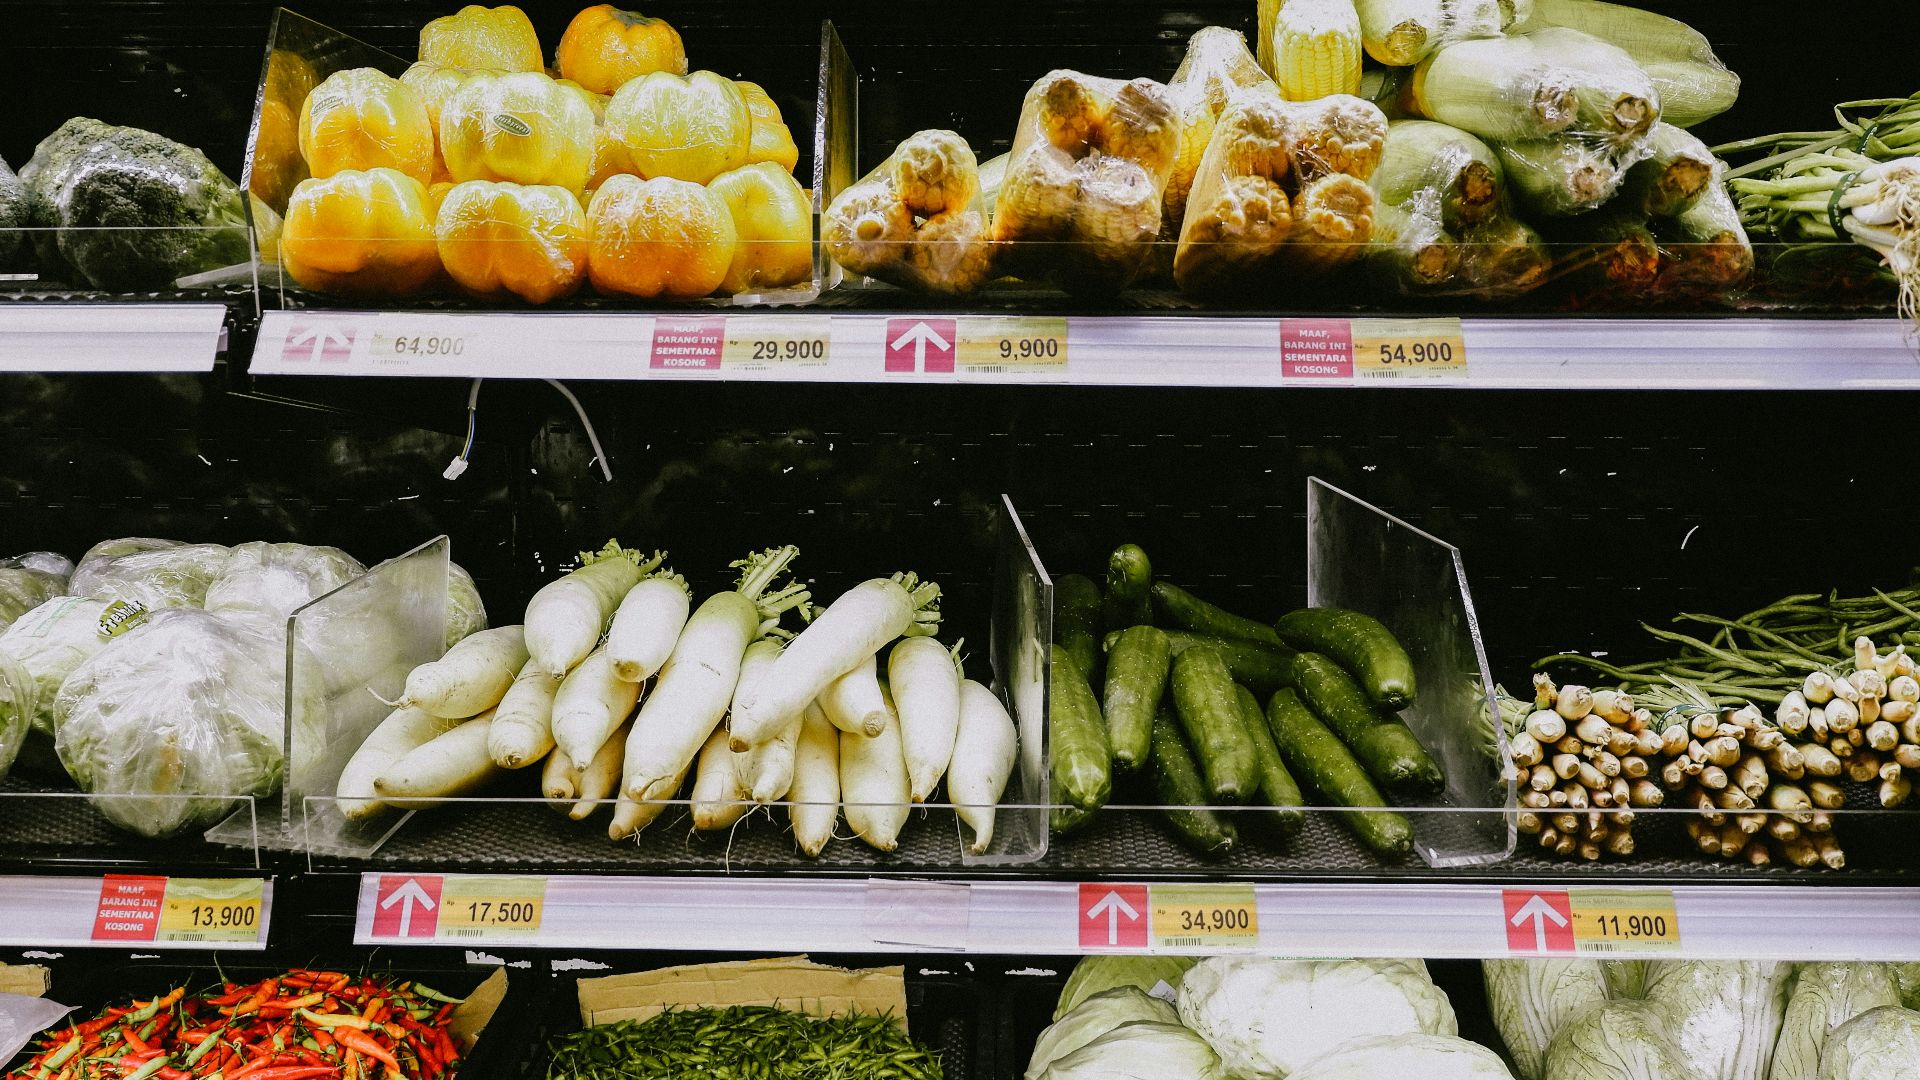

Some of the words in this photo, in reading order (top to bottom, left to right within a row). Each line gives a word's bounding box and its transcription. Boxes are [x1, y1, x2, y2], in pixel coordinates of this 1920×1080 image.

[1299, 329, 1331, 339] MAAF,
[657, 336, 698, 344] BARANG
[701, 336, 718, 344] INI
[394, 336, 465, 357] 64,900
[752, 339, 824, 362] 29,900
[1000, 338, 1058, 361] 9,900
[1284, 341, 1327, 350] BARANG
[1329, 342, 1347, 350] INI
[655, 347, 717, 355] SEMENTARA
[1380, 342, 1453, 366] 54,900
[663, 358, 707, 367] KOSONG
[1284, 353, 1347, 362] SEMENTARA
[1294, 365, 1339, 374] KOSONG
[118, 885, 145, 896] MAAF,
[101, 897, 140, 907] BARANG
[141, 898, 158, 907] INI
[98, 909, 155, 919] SEMENTARA
[191, 905, 255, 929] 13,900
[468, 901, 534, 925] 17,500
[1180, 908, 1249, 933] 34,900
[104, 921, 144, 931] KOSONG
[1597, 915, 1667, 940] 11,900
